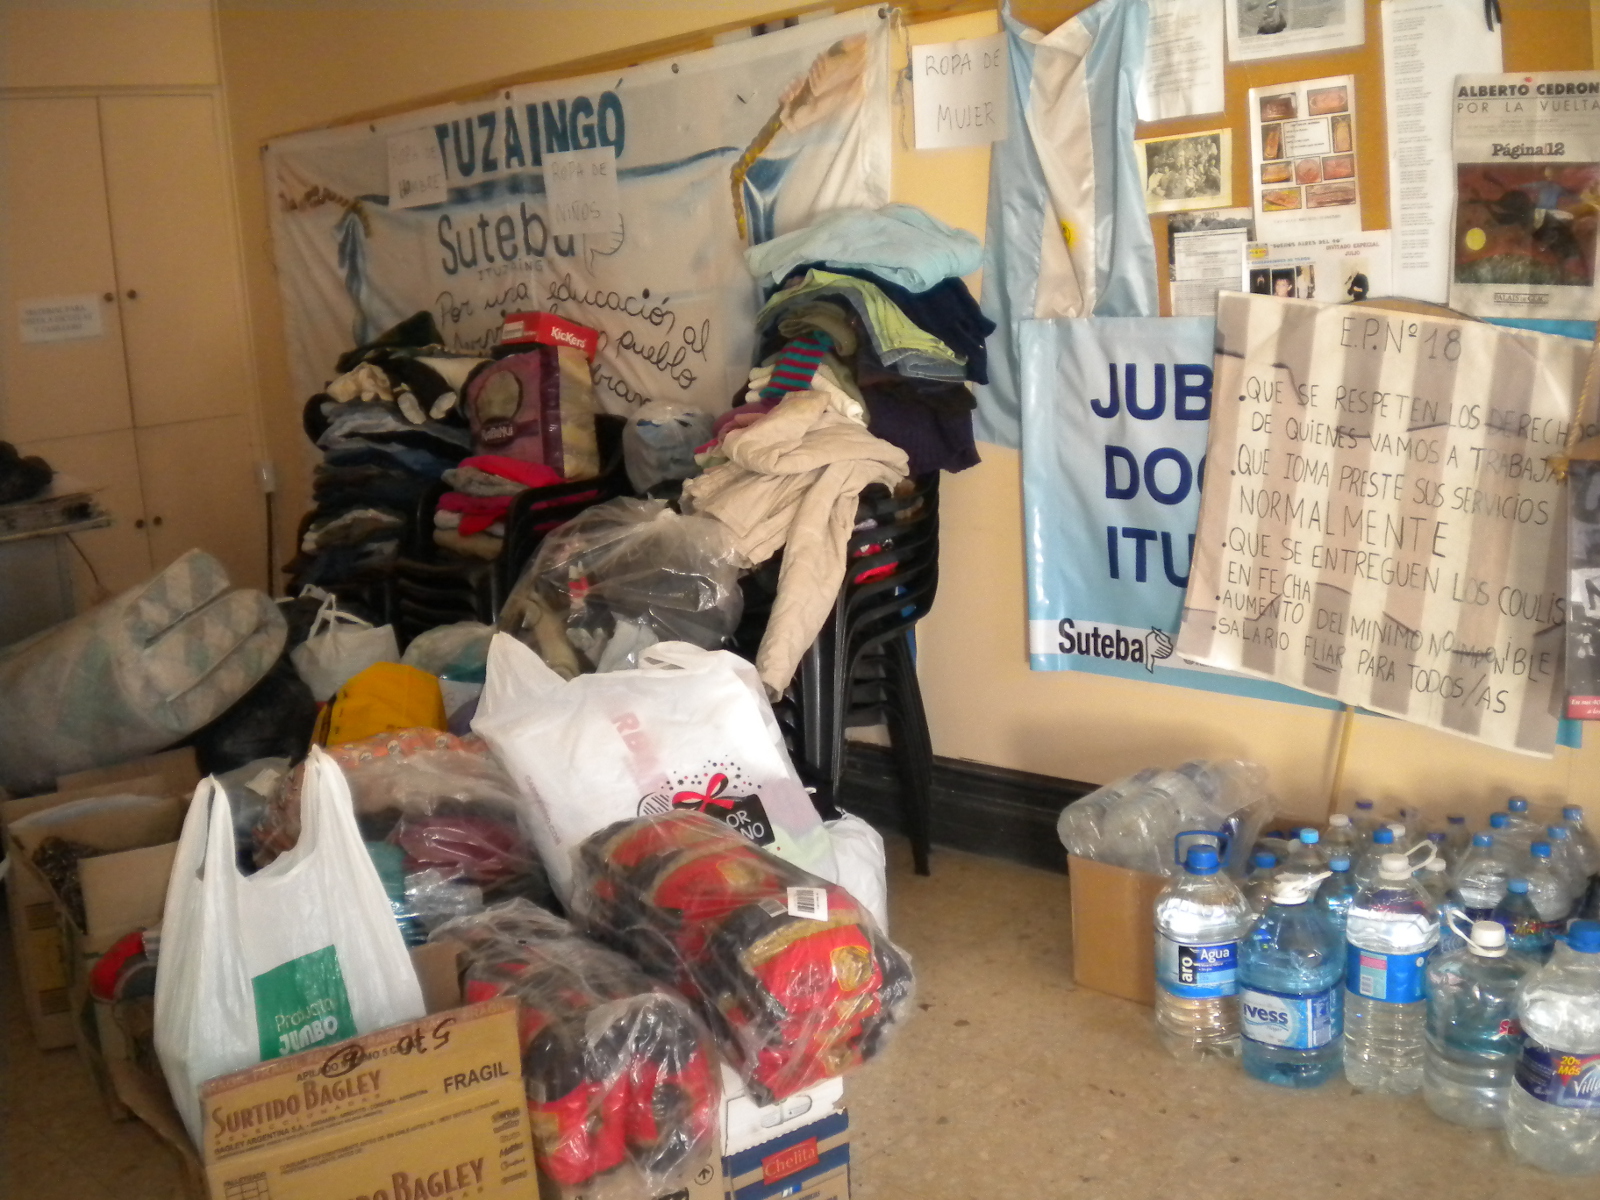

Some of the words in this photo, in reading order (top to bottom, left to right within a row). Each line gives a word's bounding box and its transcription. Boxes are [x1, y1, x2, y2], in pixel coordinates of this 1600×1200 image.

[926, 53, 972, 76] ROPA
[983, 49, 1000, 69] DE
[1457, 102, 1489, 113] POR
[1505, 102, 1524, 112] LA
[1540, 99, 1600, 112] VUELTA
[1458, 84, 1530, 97] ALBERTO
[1536, 82, 1600, 95] CEDRON
[937, 101, 996, 133] MUJER
[551, 161, 584, 183] ROPA
[591, 161, 607, 177] DE
[435, 291, 473, 327] Por
[484, 283, 530, 310] una
[547, 273, 676, 335] educación
[683, 318, 710, 362] al
[616, 330, 697, 390] pueblo
[1424, 328, 1461, 361] 18
[1247, 376, 1284, 404] QUE
[1297, 384, 1319, 407] SE
[1335, 385, 1438, 423] RESPETEN
[1449, 403, 1480, 430] LOS
[1252, 411, 1272, 434] DE
[1370, 433, 1439, 464] VAMOS
[1447, 445, 1458, 468] A
[1238, 444, 1270, 476] QUE
[1284, 453, 1330, 487] IOMA
[1339, 465, 1404, 501] PRESTE
[1413, 478, 1445, 508] SUS
[1228, 561, 1251, 587] EN
[1258, 567, 1311, 603] FECHA
[1229, 527, 1271, 557] QUE
[1281, 538, 1302, 565] SE
[1312, 545, 1439, 593] ENTREGUEN
[1452, 572, 1489, 606] LOS
[1058, 617, 1145, 664] Suteba
[1222, 589, 1304, 624] AUMENTO
[1317, 608, 1344, 635] DEL
[1351, 615, 1423, 651] MINIMO
[1429, 630, 1455, 657] NO
[1218, 617, 1290, 650] SALARIO
[1358, 649, 1395, 682] PARA
[1408, 664, 1508, 713] TODOS/AS
[1181, 956, 1193, 982] aro
[1201, 948, 1229, 963] Agua
[279, 1016, 338, 1055] JUMBO
[443, 1061, 509, 1093] FRAGIL
[1561, 1055, 1581, 1066] 20%
[212, 1094, 299, 1139] SURTIDO
[302, 1069, 382, 1112] BAGLEY
[214, 1141, 245, 1155] BAGLEY
[246, 1128, 290, 1145] ARGENTINA
[391, 1156, 484, 1200] BAGLEY
[764, 1148, 816, 1177] Chelita
